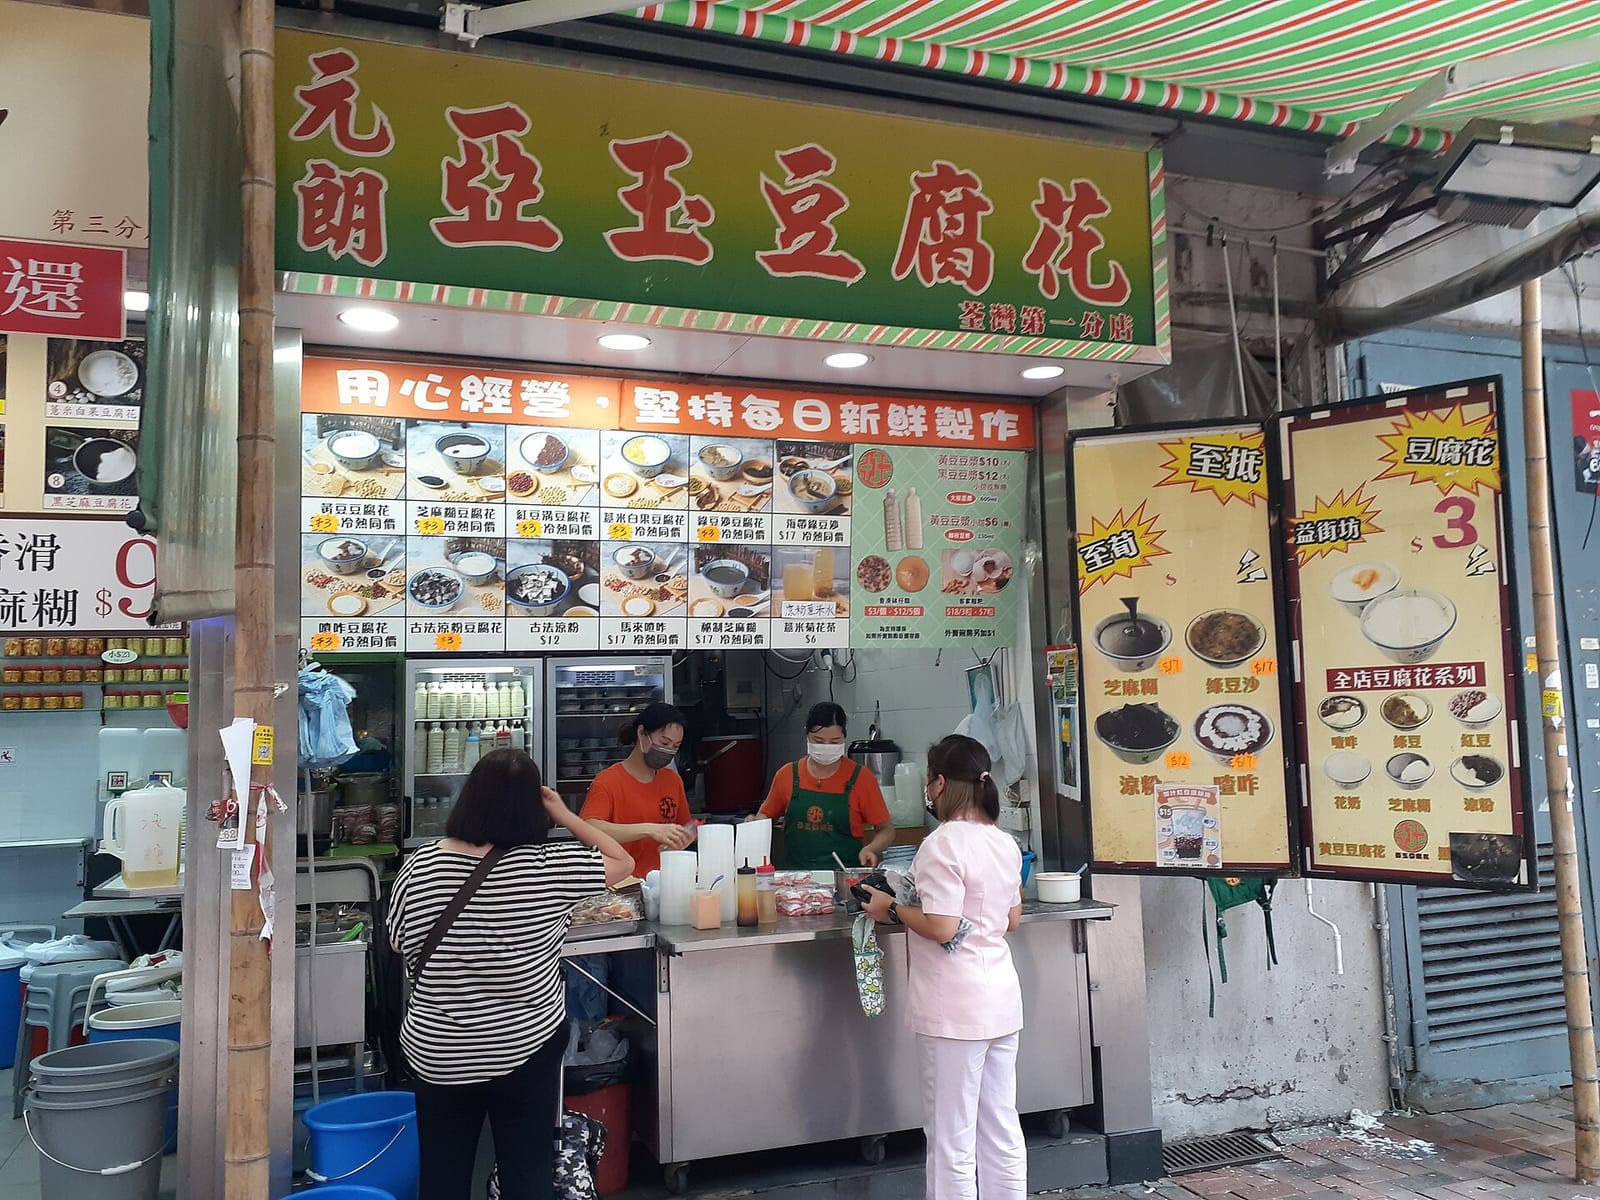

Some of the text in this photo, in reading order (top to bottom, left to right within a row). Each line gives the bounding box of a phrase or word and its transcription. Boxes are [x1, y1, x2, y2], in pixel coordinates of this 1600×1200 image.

[289, 47, 395, 267] 元朗
[429, 102, 1131, 308] 亞玉豆腐花
[50, 208, 149, 240] 第三分
[1, 256, 85, 319] 還
[958, 300, 1134, 343] 荃灣第一分店
[1404, 436, 1496, 467] 豆腐花
[1186, 443, 1264, 484] 至抵
[1294, 516, 1362, 545] 益街坊
[1431, 496, 1479, 549] 3
[540, 636, 560, 645] $12
[607, 635, 626, 645] $17
[695, 634, 713, 644] $17
[805, 634, 817, 643] $6
[1103, 677, 1159, 696] 芝麻糊
[1206, 676, 1260, 695] 綠豆沙
[1333, 665, 1477, 690] 全店豆腐花系列
[1392, 735, 1422, 749] 綠豆
[1460, 733, 1491, 748] 紅豆
[1334, 796, 1361, 810] 花奶
[1388, 798, 1431, 813] 芝麻糊
[1319, 842, 1386, 859] 黃豆豆腐花
